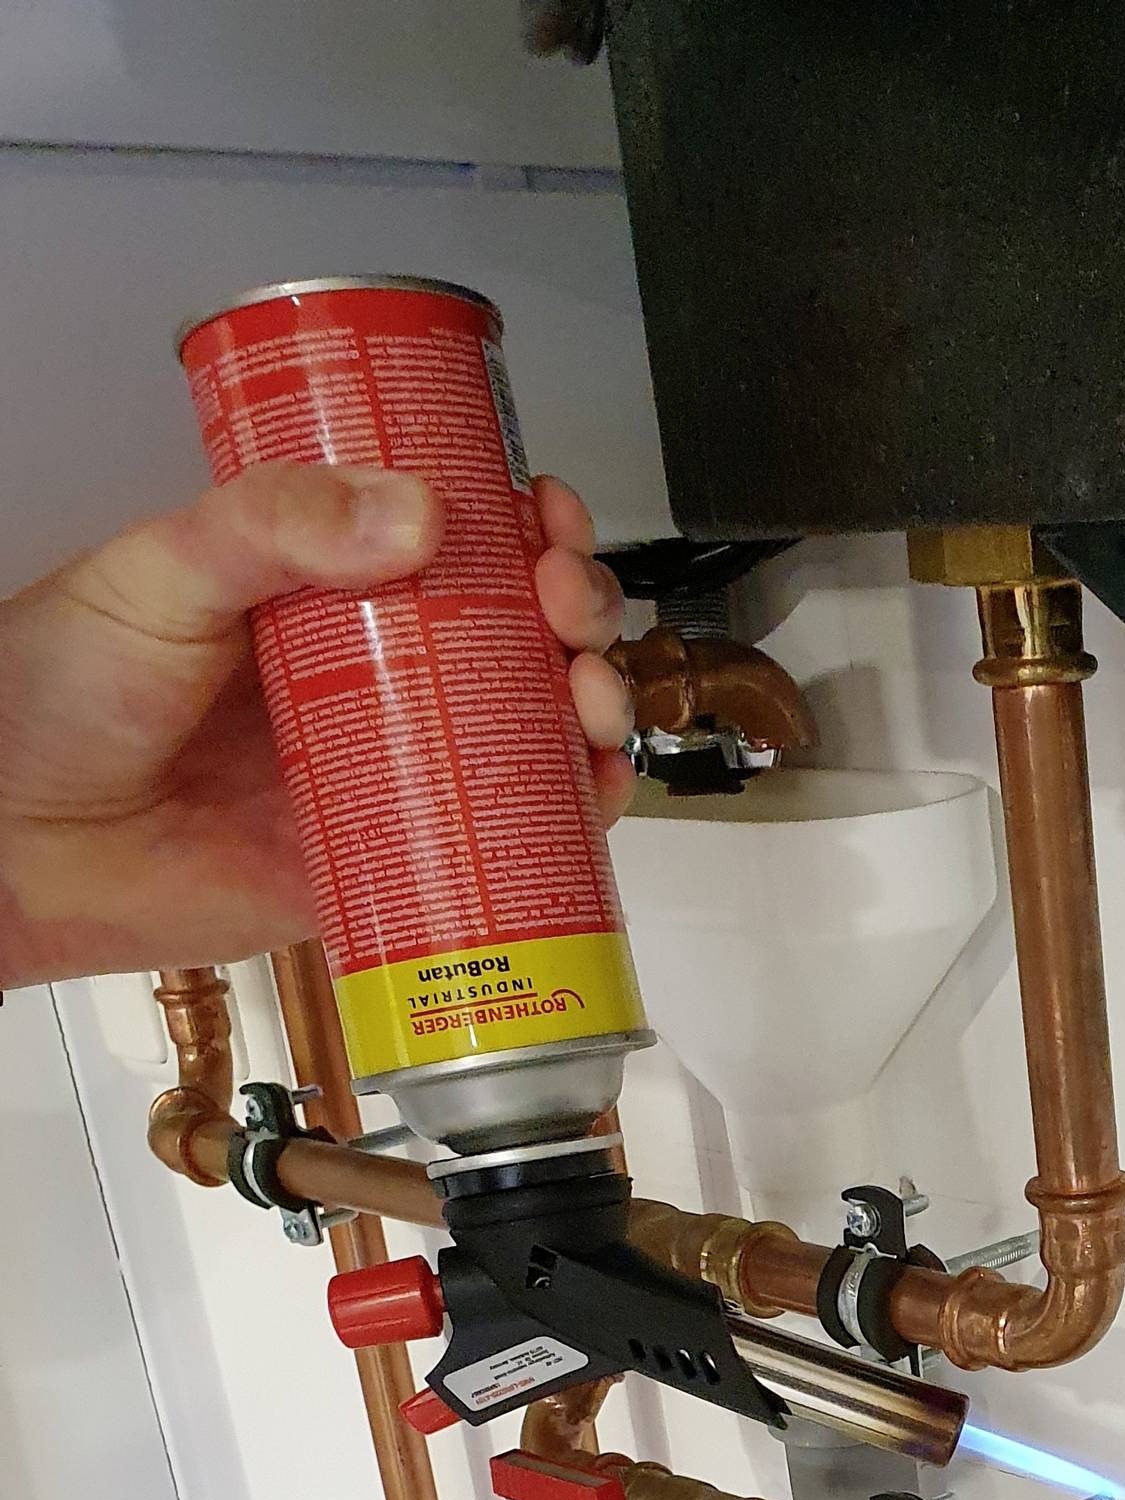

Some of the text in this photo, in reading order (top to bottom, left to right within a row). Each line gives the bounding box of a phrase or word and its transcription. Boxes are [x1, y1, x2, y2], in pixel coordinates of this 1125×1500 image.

[417, 955, 511, 982] RoButan
[407, 977, 534, 1009] INDUSTRIAL
[412, 997, 568, 1036] ROTHENBERGER
